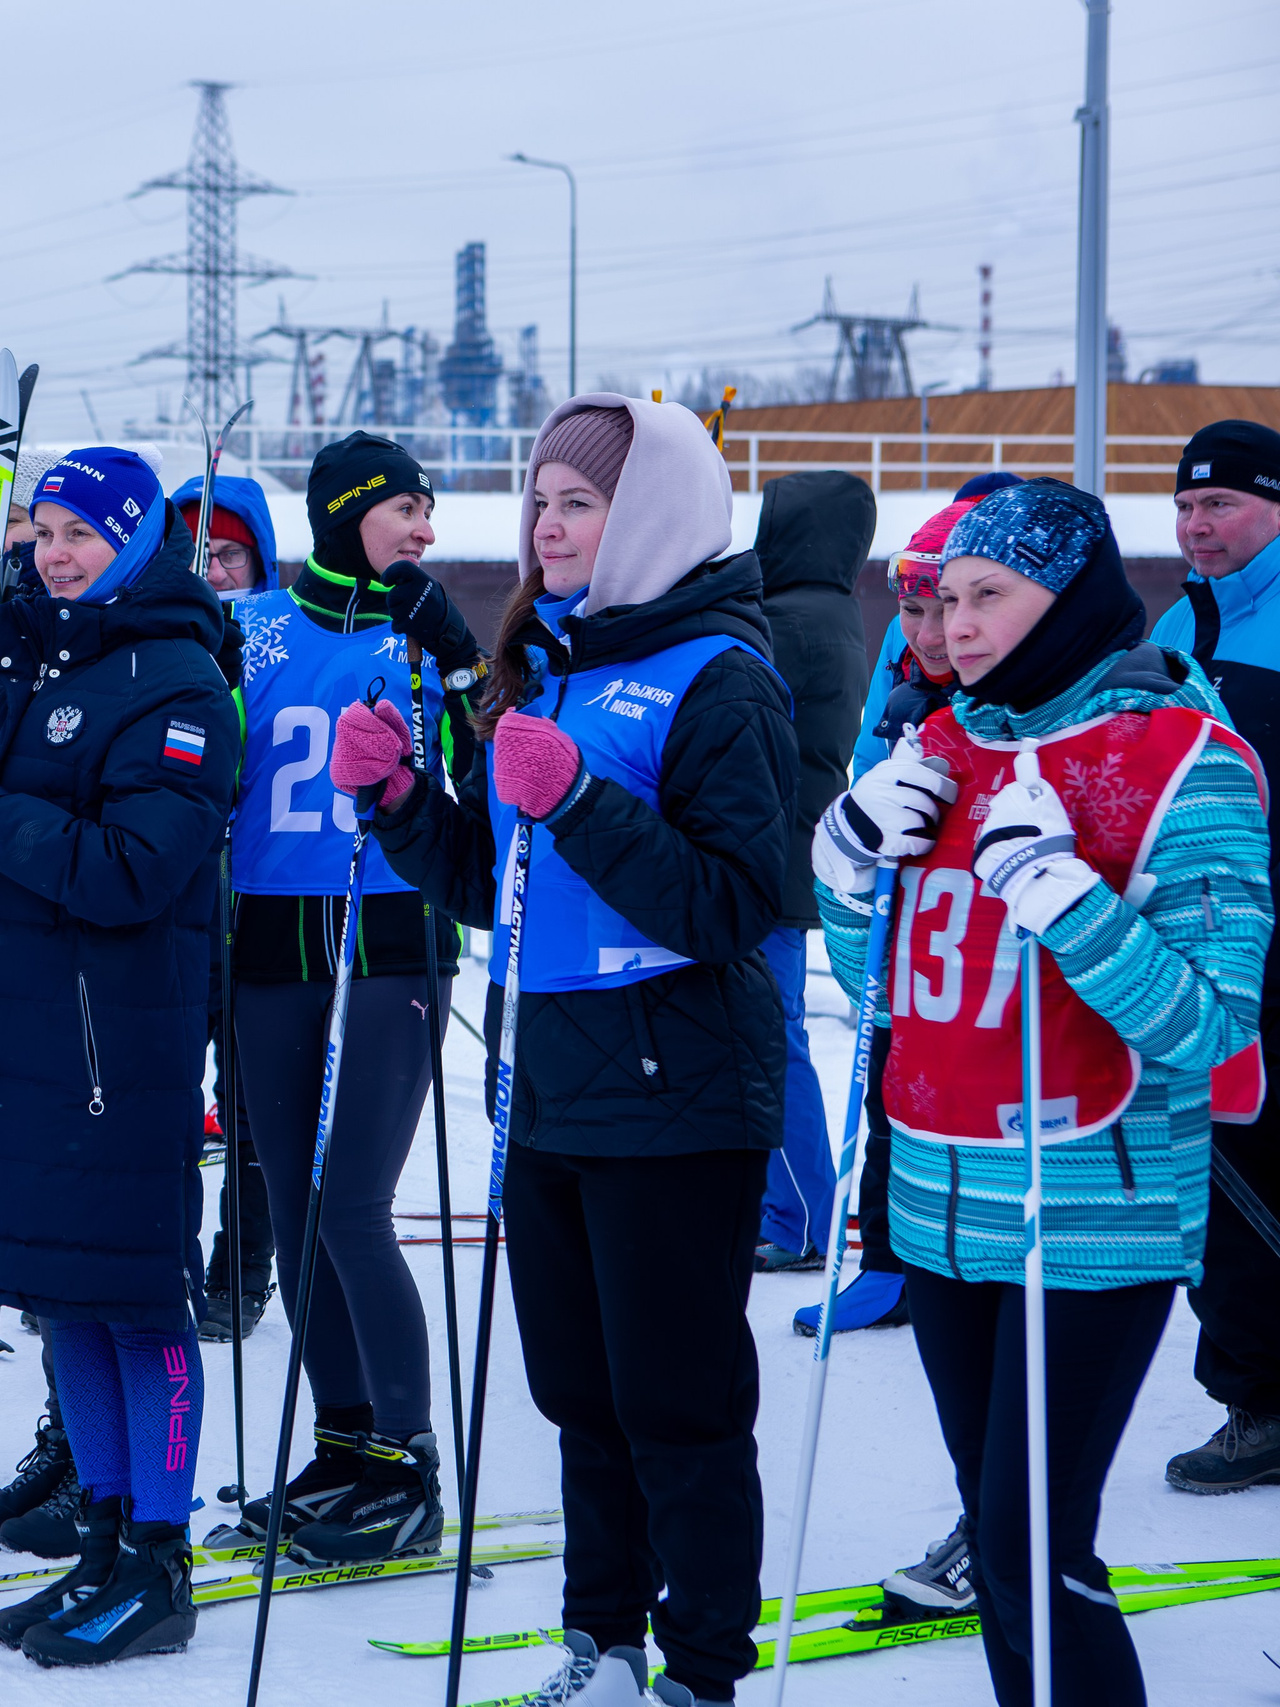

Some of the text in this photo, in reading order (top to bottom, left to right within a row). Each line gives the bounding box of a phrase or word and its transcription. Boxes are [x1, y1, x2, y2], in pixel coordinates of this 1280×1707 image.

[326, 474, 387, 514] SPINE
[104, 516, 130, 544] salo
[408, 580, 434, 620] MADSHUS
[455, 674, 468, 683] 195
[621, 681, 675, 708] ЛЫЖНЯ
[170, 720, 206, 736] RUSSIA
[609, 699, 648, 721] МОЭК
[411, 699, 426, 769] RDWAY
[991, 847, 1037, 889] NORDWAY
[507, 863, 526, 976] XC ACTIVE
[892, 865, 1021, 1029] 137
[854, 974, 880, 1085] NORDWAY
[312, 1040, 336, 1191] NORDWAY
[488, 1059, 513, 1224] NORDWAY
[163, 1345, 191, 1472] SPINE
[351, 1491, 408, 1520] FISCHER
[231, 1541, 293, 1561] FISC
[282, 1563, 385, 1589] FISCHER
[77, 1598, 134, 1634] salomon
[875, 1619, 980, 1646] FISCHER
